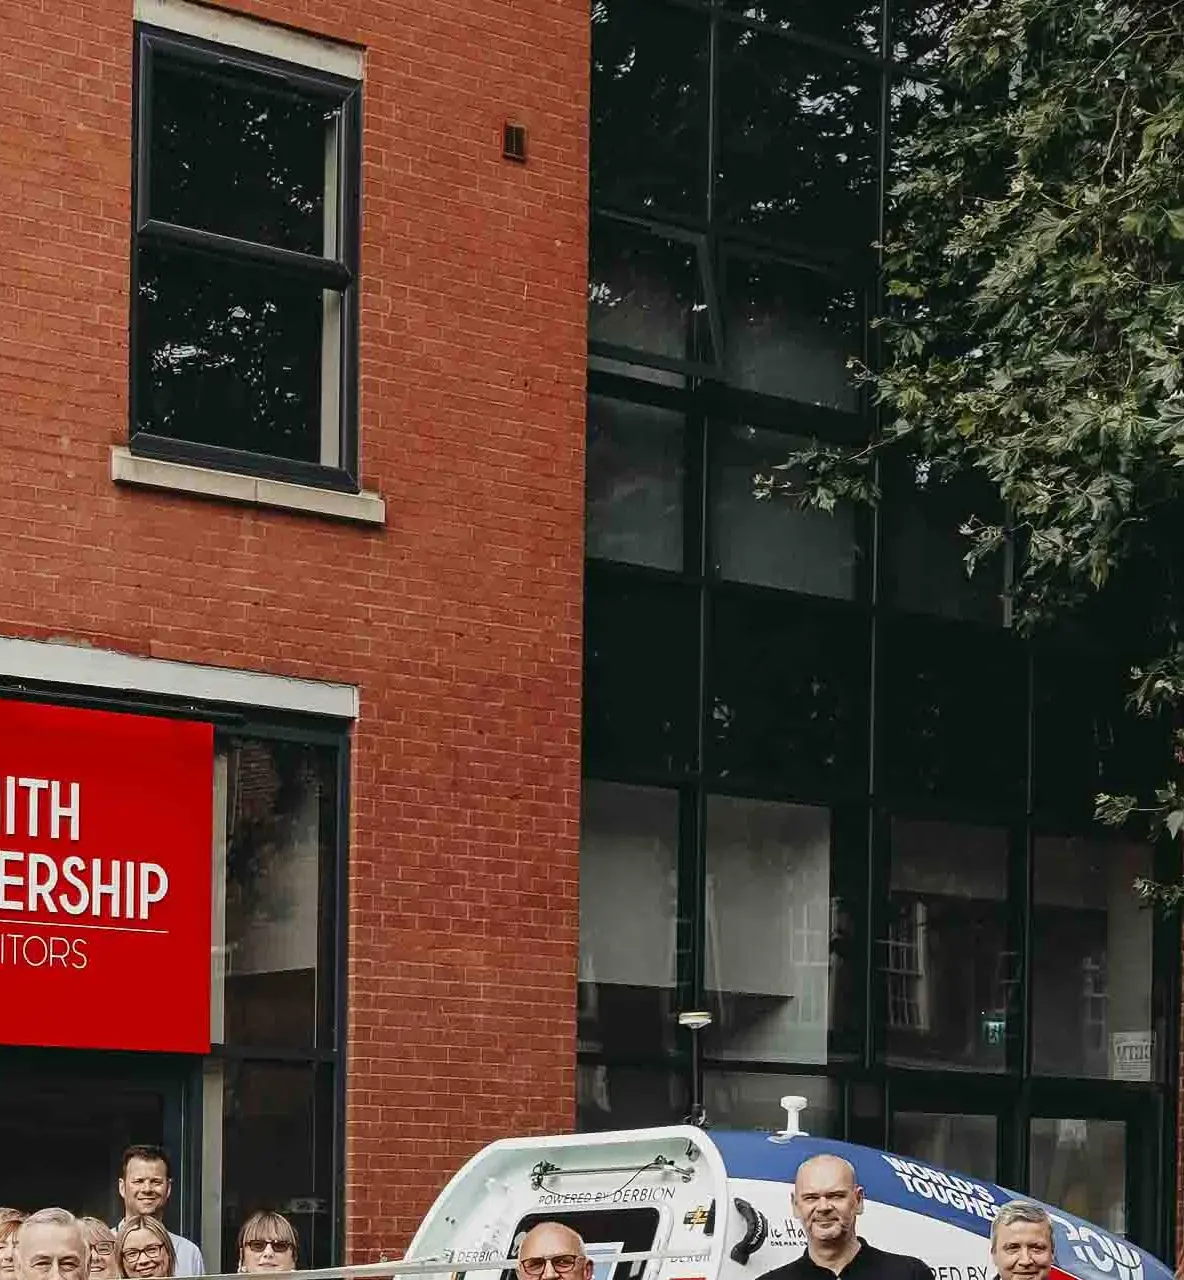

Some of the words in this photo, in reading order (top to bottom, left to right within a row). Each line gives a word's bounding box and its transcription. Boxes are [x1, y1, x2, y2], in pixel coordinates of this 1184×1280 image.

[613, 1186, 677, 1203] DERBION
[881, 1154, 995, 1203] WORLD'S
[896, 1171, 1000, 1222] TOUGHES
[785, 1218, 806, 1239] Ha
